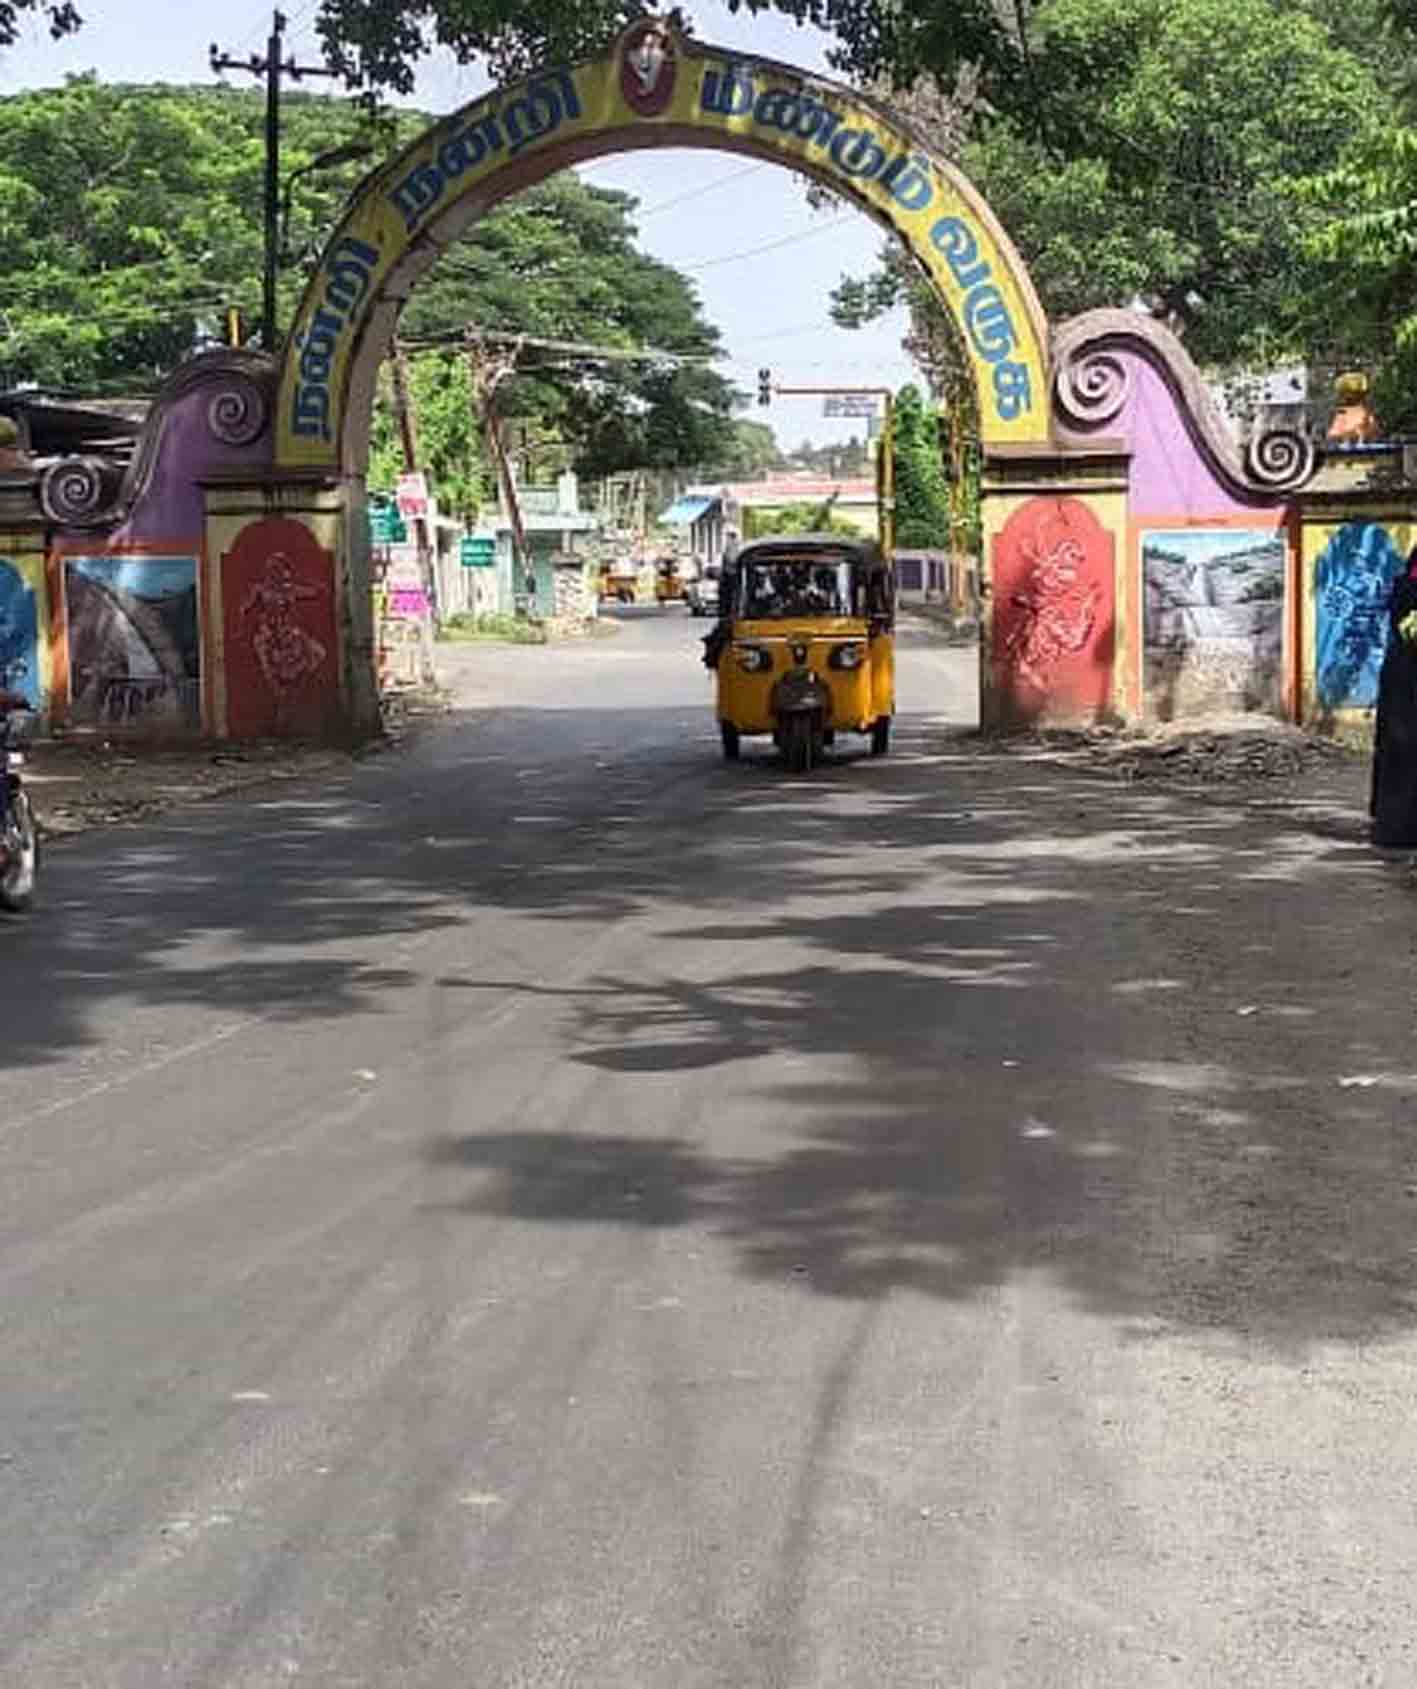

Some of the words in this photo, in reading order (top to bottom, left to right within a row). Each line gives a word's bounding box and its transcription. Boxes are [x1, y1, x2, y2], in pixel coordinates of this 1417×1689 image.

[291, 239, 380, 441] நன்றி
[389, 67, 581, 231] நன்றி
[701, 65, 933, 211] மீண்டும்
[930, 216, 1031, 421] வருக
